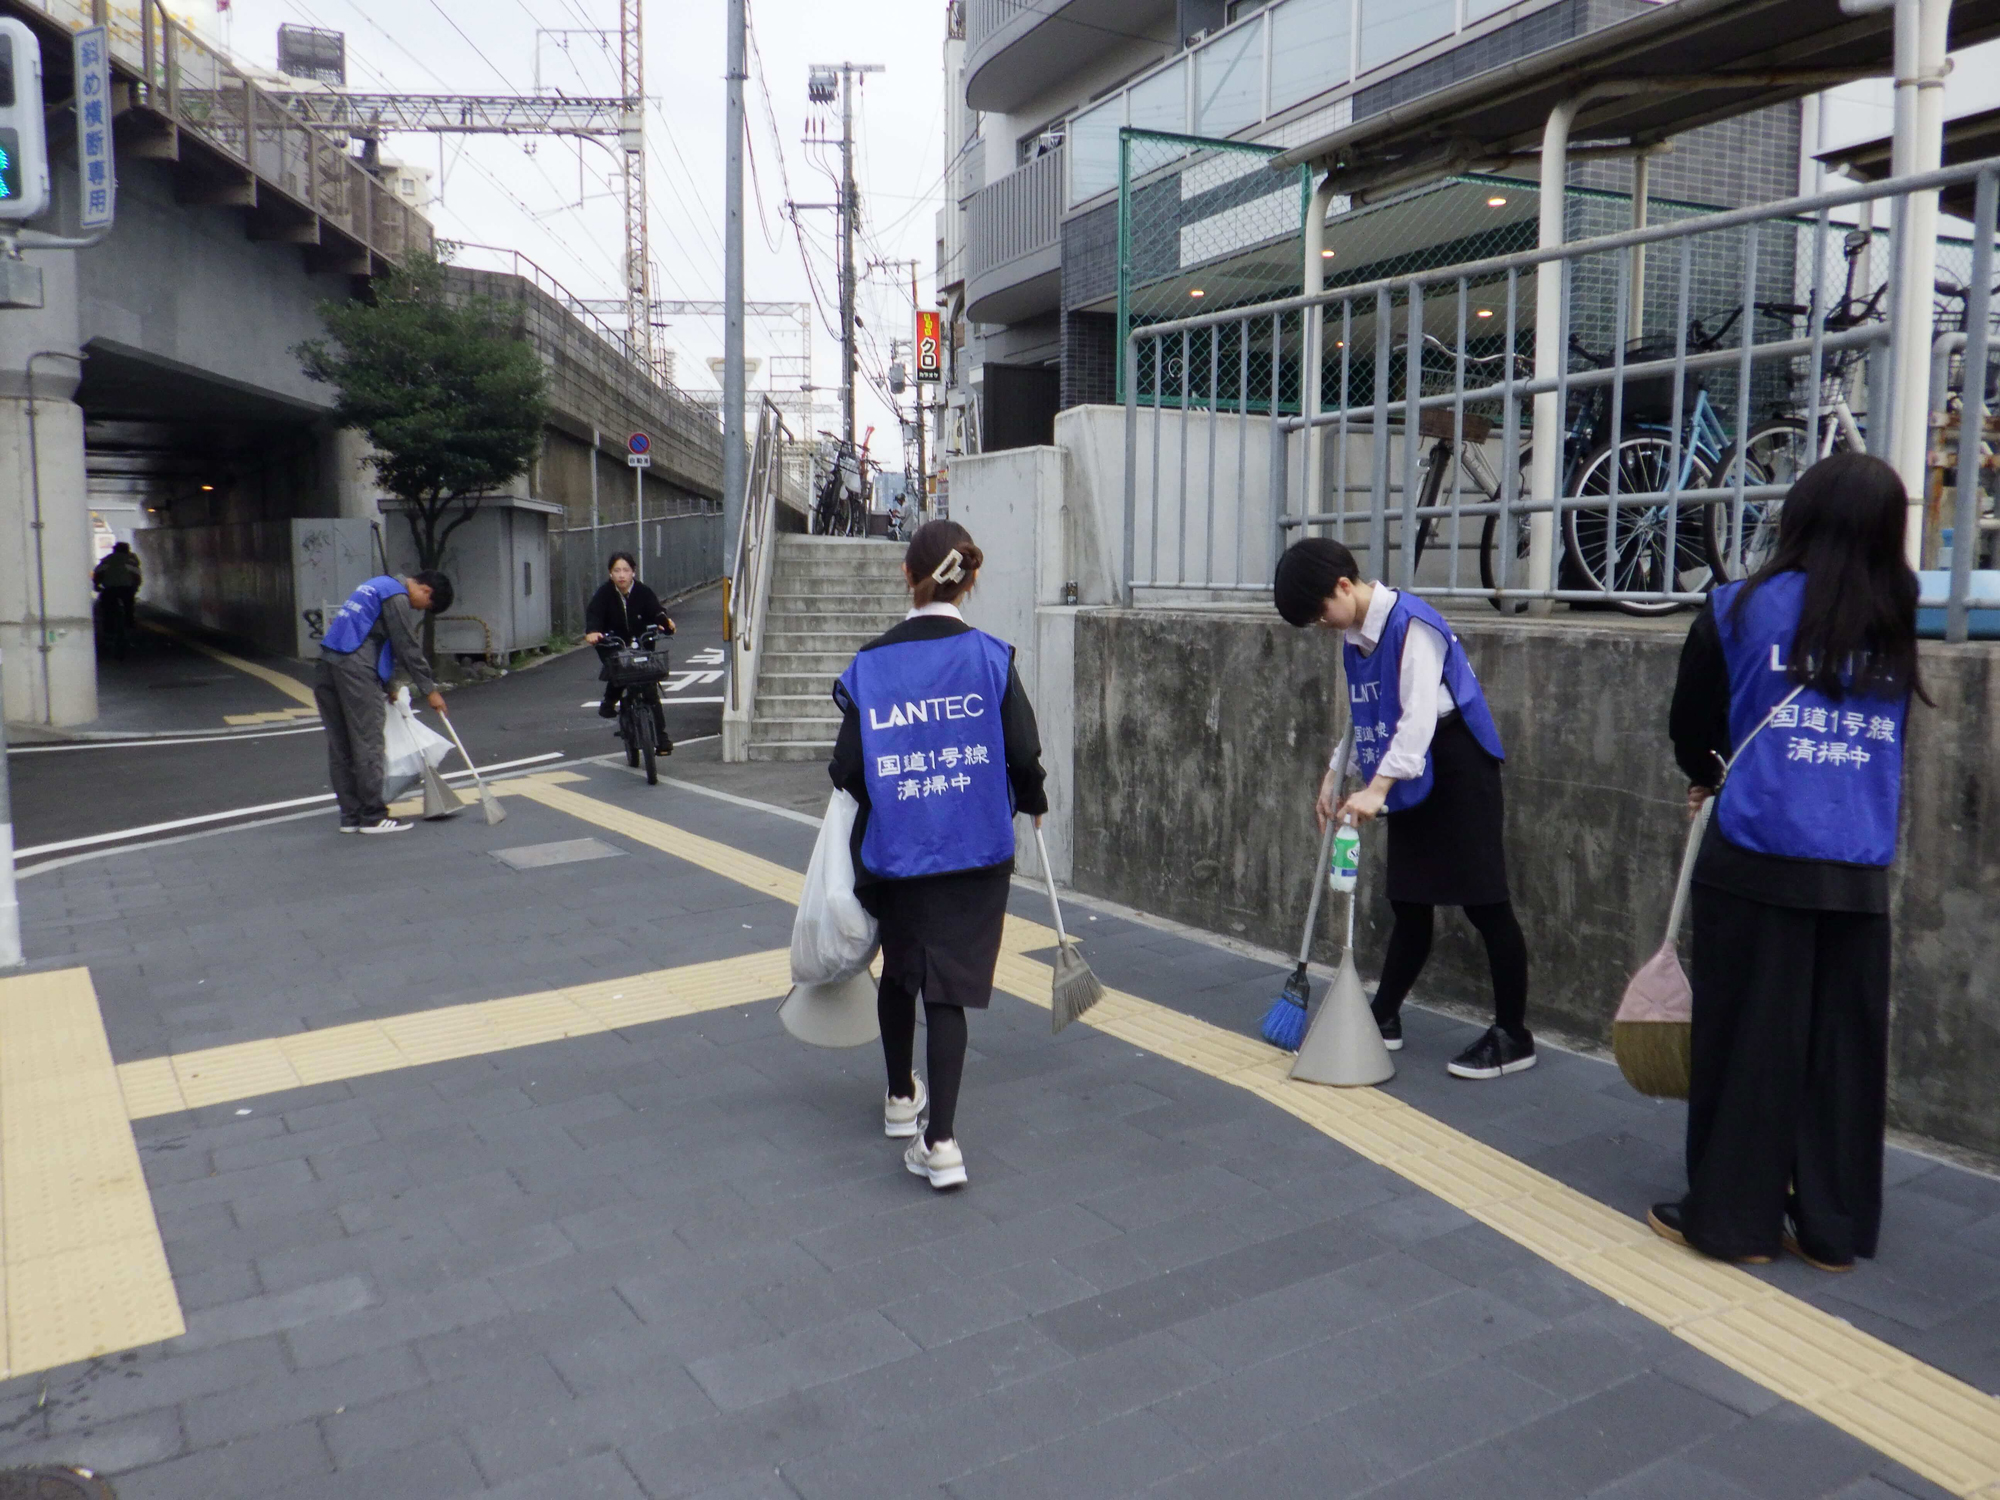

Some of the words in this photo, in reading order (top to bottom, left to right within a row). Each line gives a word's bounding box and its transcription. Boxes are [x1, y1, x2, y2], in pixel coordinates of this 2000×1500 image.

[81, 38, 106, 216] 斜め横断専用
[869, 693, 984, 730] LANTEC
[1769, 704, 1896, 743] 国道1号線
[877, 744, 990, 777] 国道1号線
[1787, 735, 1871, 769] 清掃中
[897, 772, 971, 801] 清掃中
